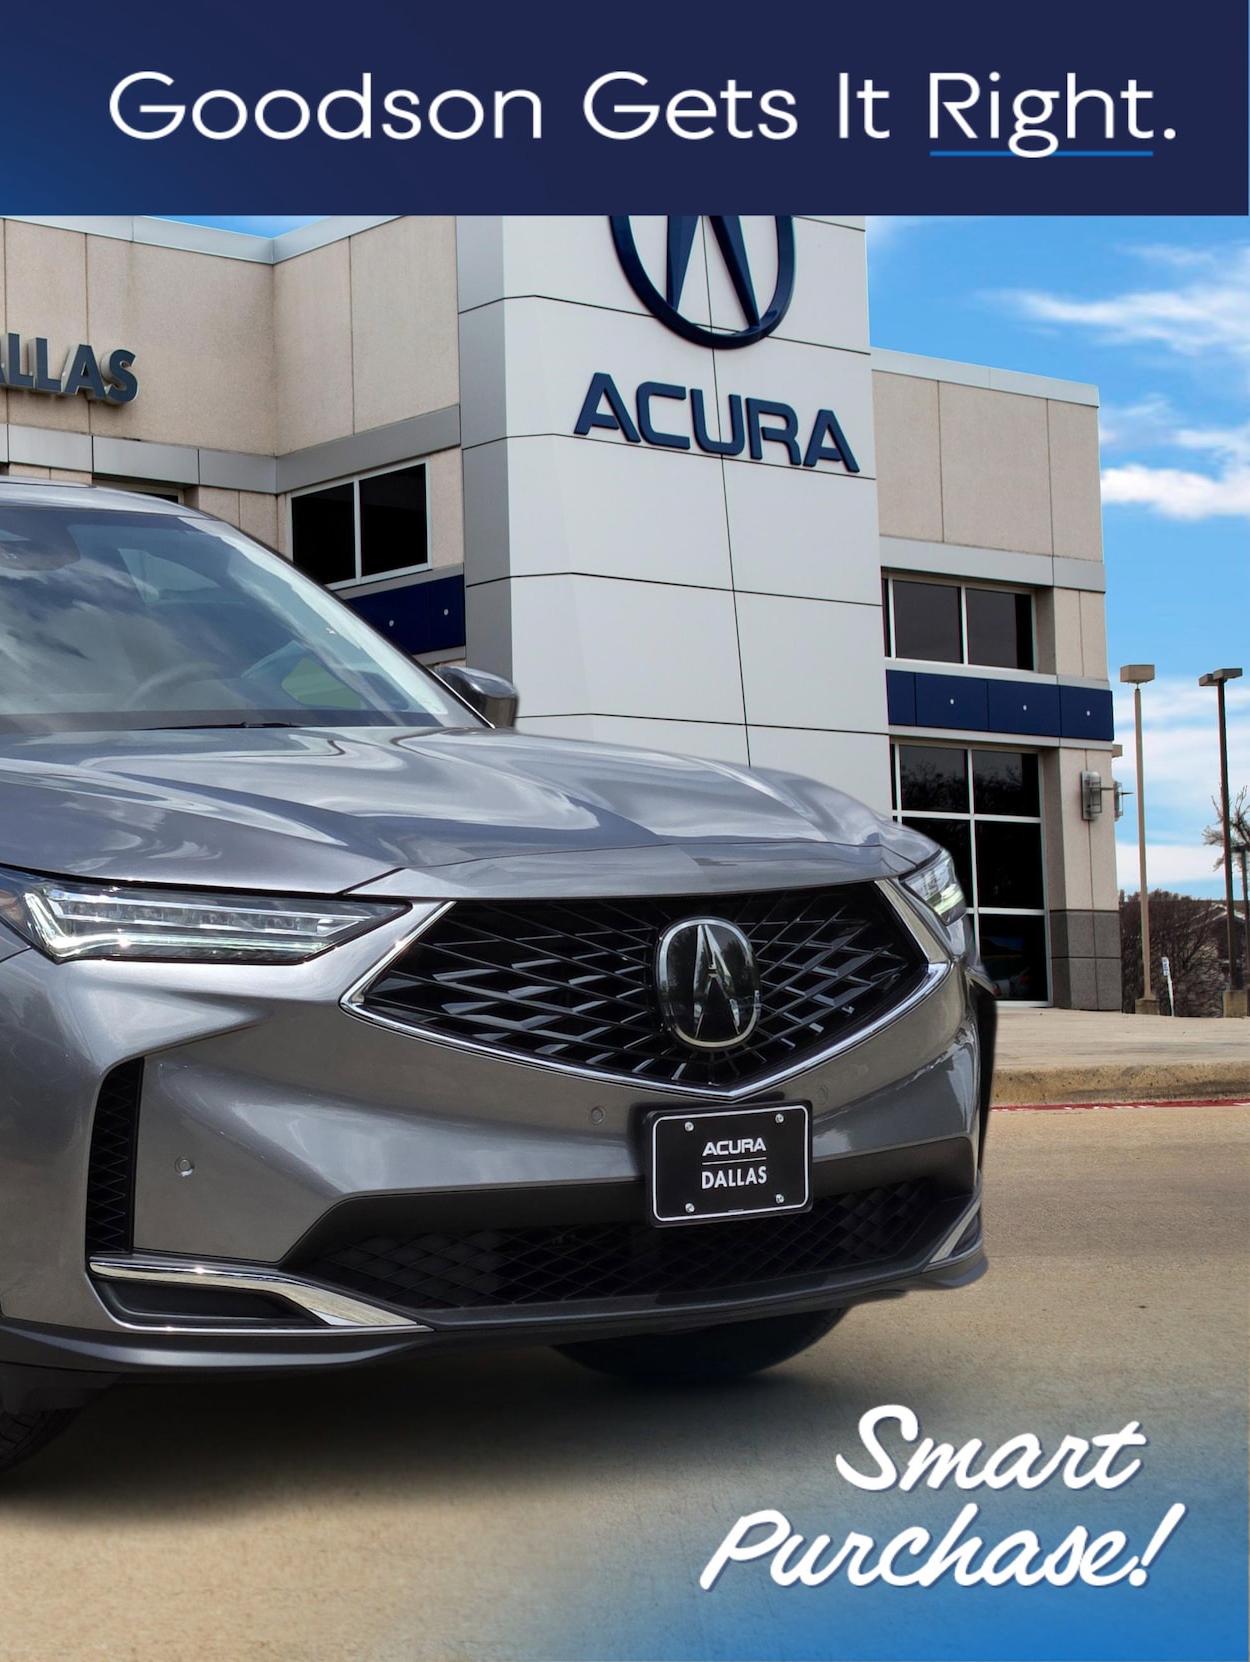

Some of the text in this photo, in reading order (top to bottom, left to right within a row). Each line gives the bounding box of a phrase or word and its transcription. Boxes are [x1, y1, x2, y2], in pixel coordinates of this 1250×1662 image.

[573, 372, 860, 473] ACURA
[703, 1138, 766, 1156] ACURA
[702, 1166, 766, 1189] DALLAS
